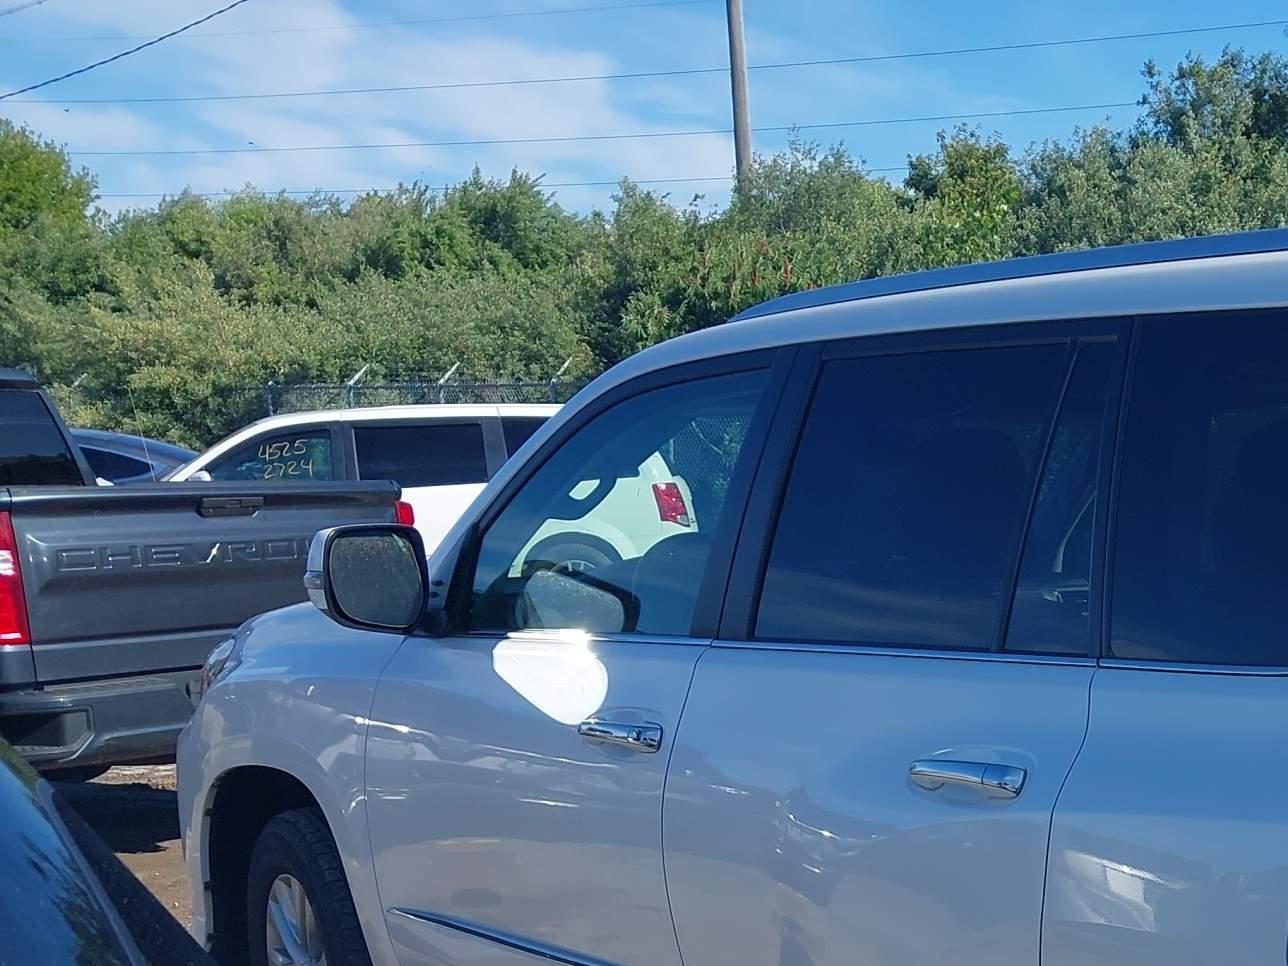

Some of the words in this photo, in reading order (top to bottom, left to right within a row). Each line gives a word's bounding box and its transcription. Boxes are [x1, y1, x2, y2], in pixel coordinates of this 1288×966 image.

[258, 439, 309, 462] 4525
[263, 458, 313, 479] 2724
[55, 538, 309, 573] CHEVRO
